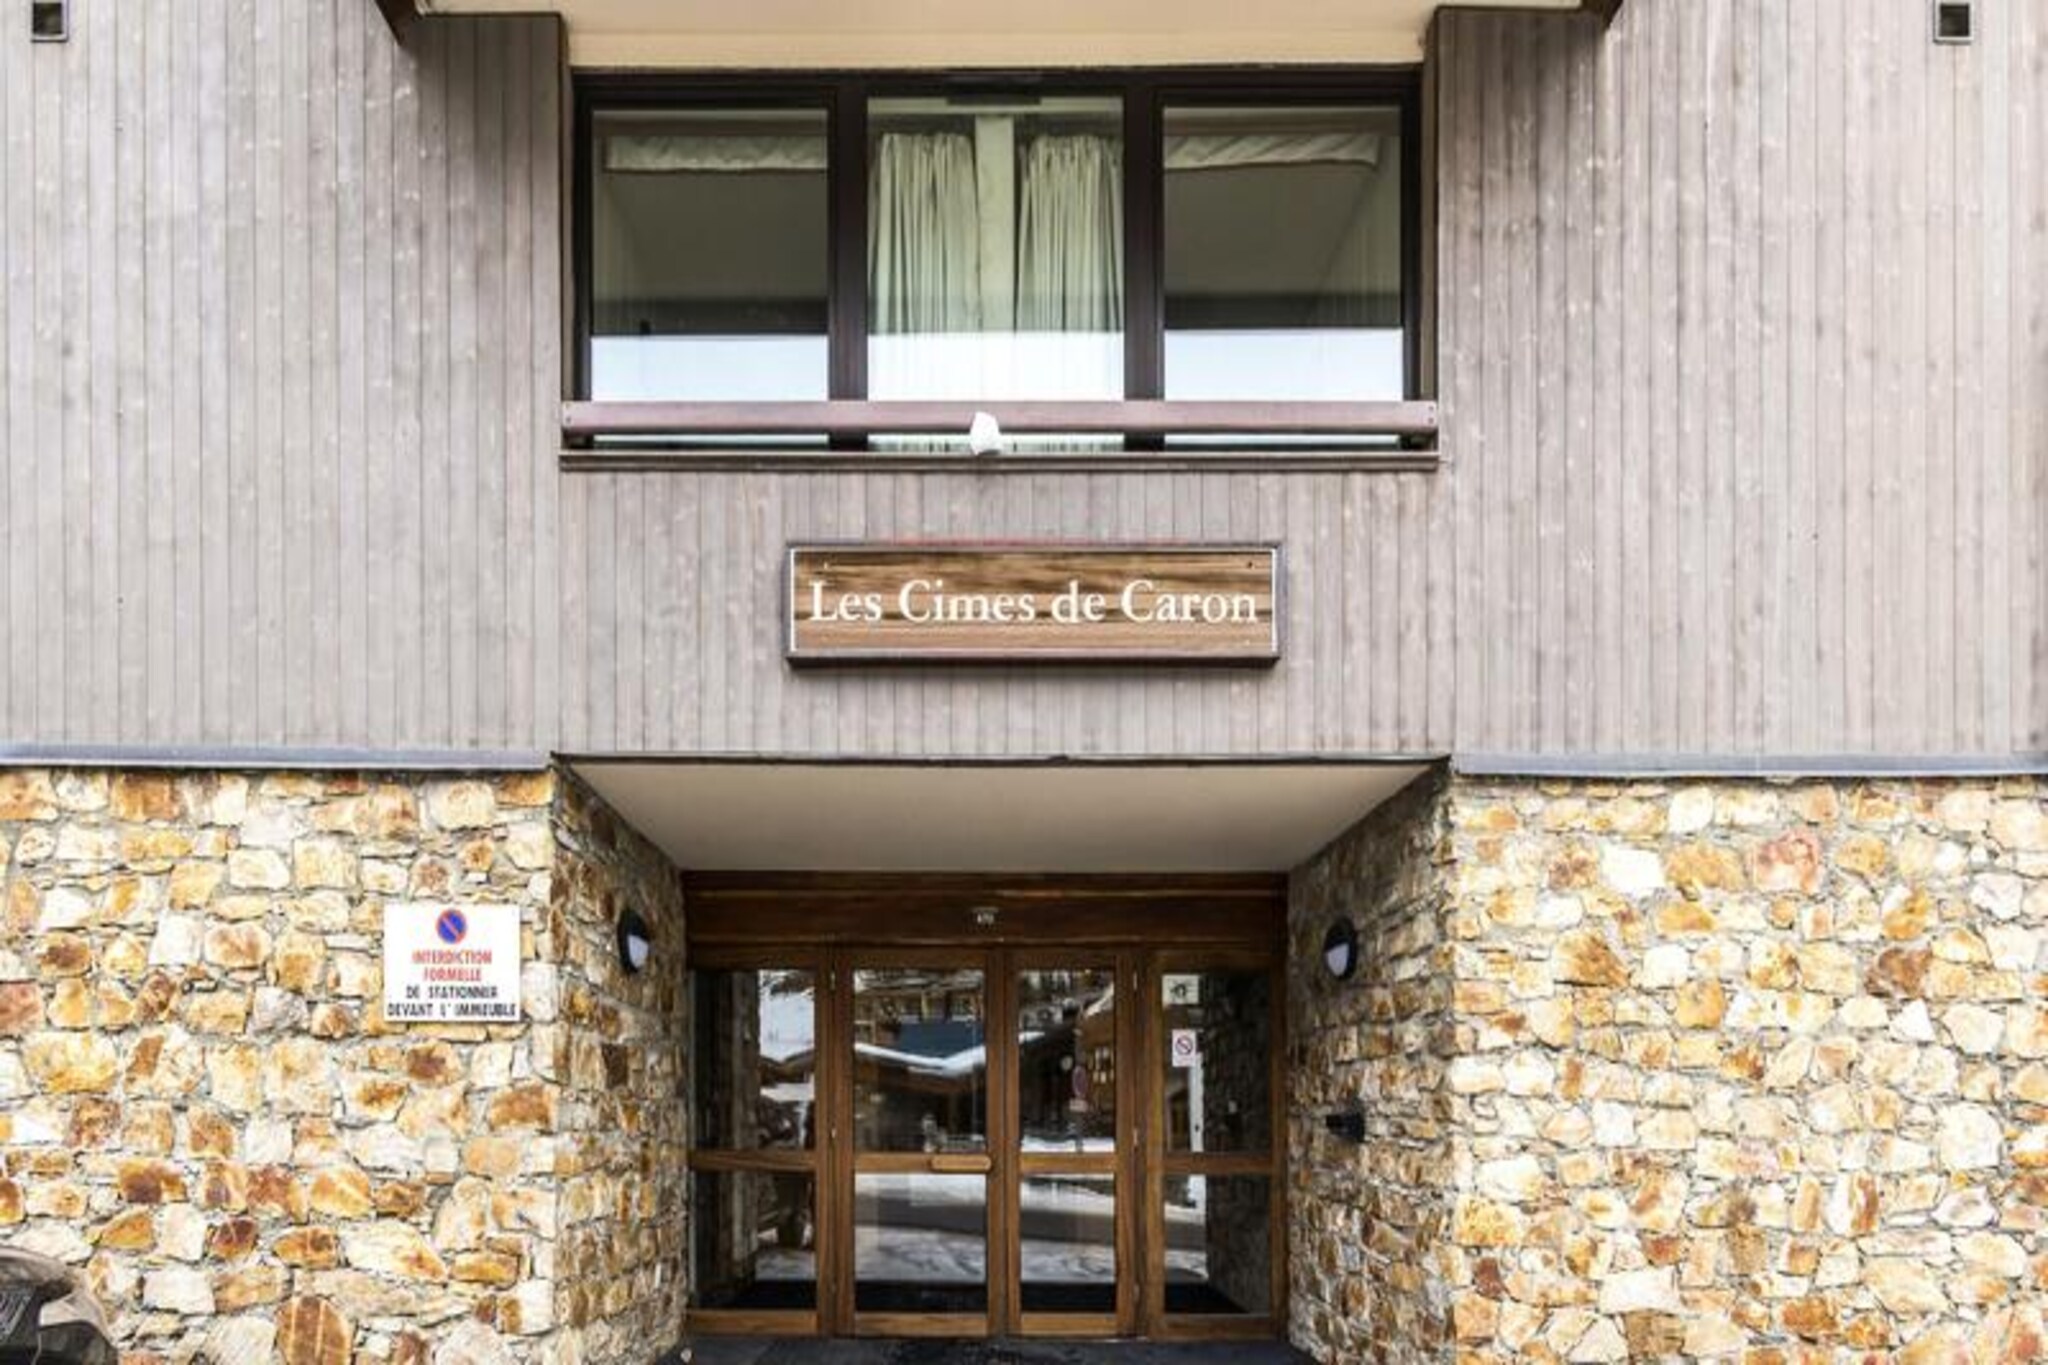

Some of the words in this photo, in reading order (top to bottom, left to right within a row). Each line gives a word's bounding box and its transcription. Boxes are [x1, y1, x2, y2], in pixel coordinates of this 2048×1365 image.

[810, 580, 882, 621] Les
[898, 579, 1036, 621] Cimes
[1051, 580, 1106, 622] de
[1121, 580, 1258, 622] Caron
[412, 950, 492, 964] INTERDICTION
[424, 967, 482, 981] FORMELLE
[405, 985, 420, 999] DE
[428, 985, 498, 999] STATIONNER
[387, 1003, 433, 1016] DEVANT
